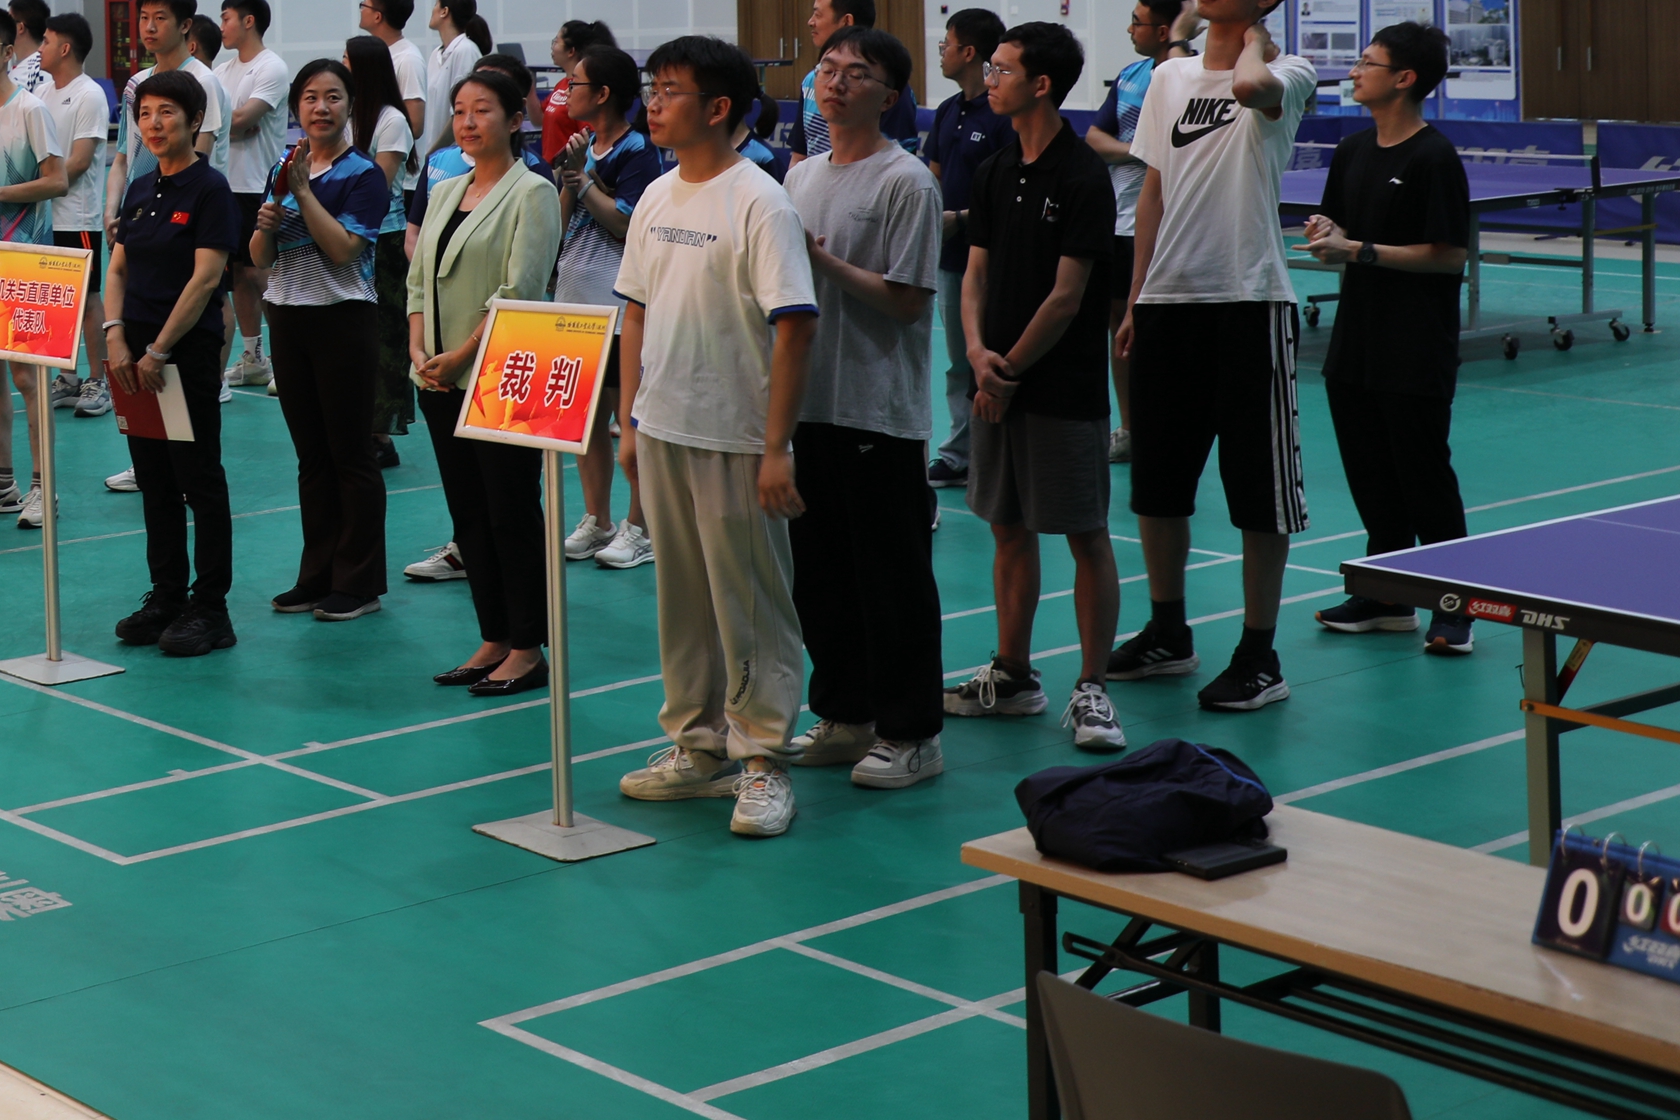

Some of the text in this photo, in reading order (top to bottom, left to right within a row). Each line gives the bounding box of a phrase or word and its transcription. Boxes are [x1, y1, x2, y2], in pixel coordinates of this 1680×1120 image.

[1180, 98, 1237, 125] NIKE
[11, 307, 46, 334] 代表队
[498, 350, 583, 409] 裁判
[1520, 609, 1570, 631] DHS
[1558, 868, 1599, 938] 0
[1626, 883, 1652, 924] 0
